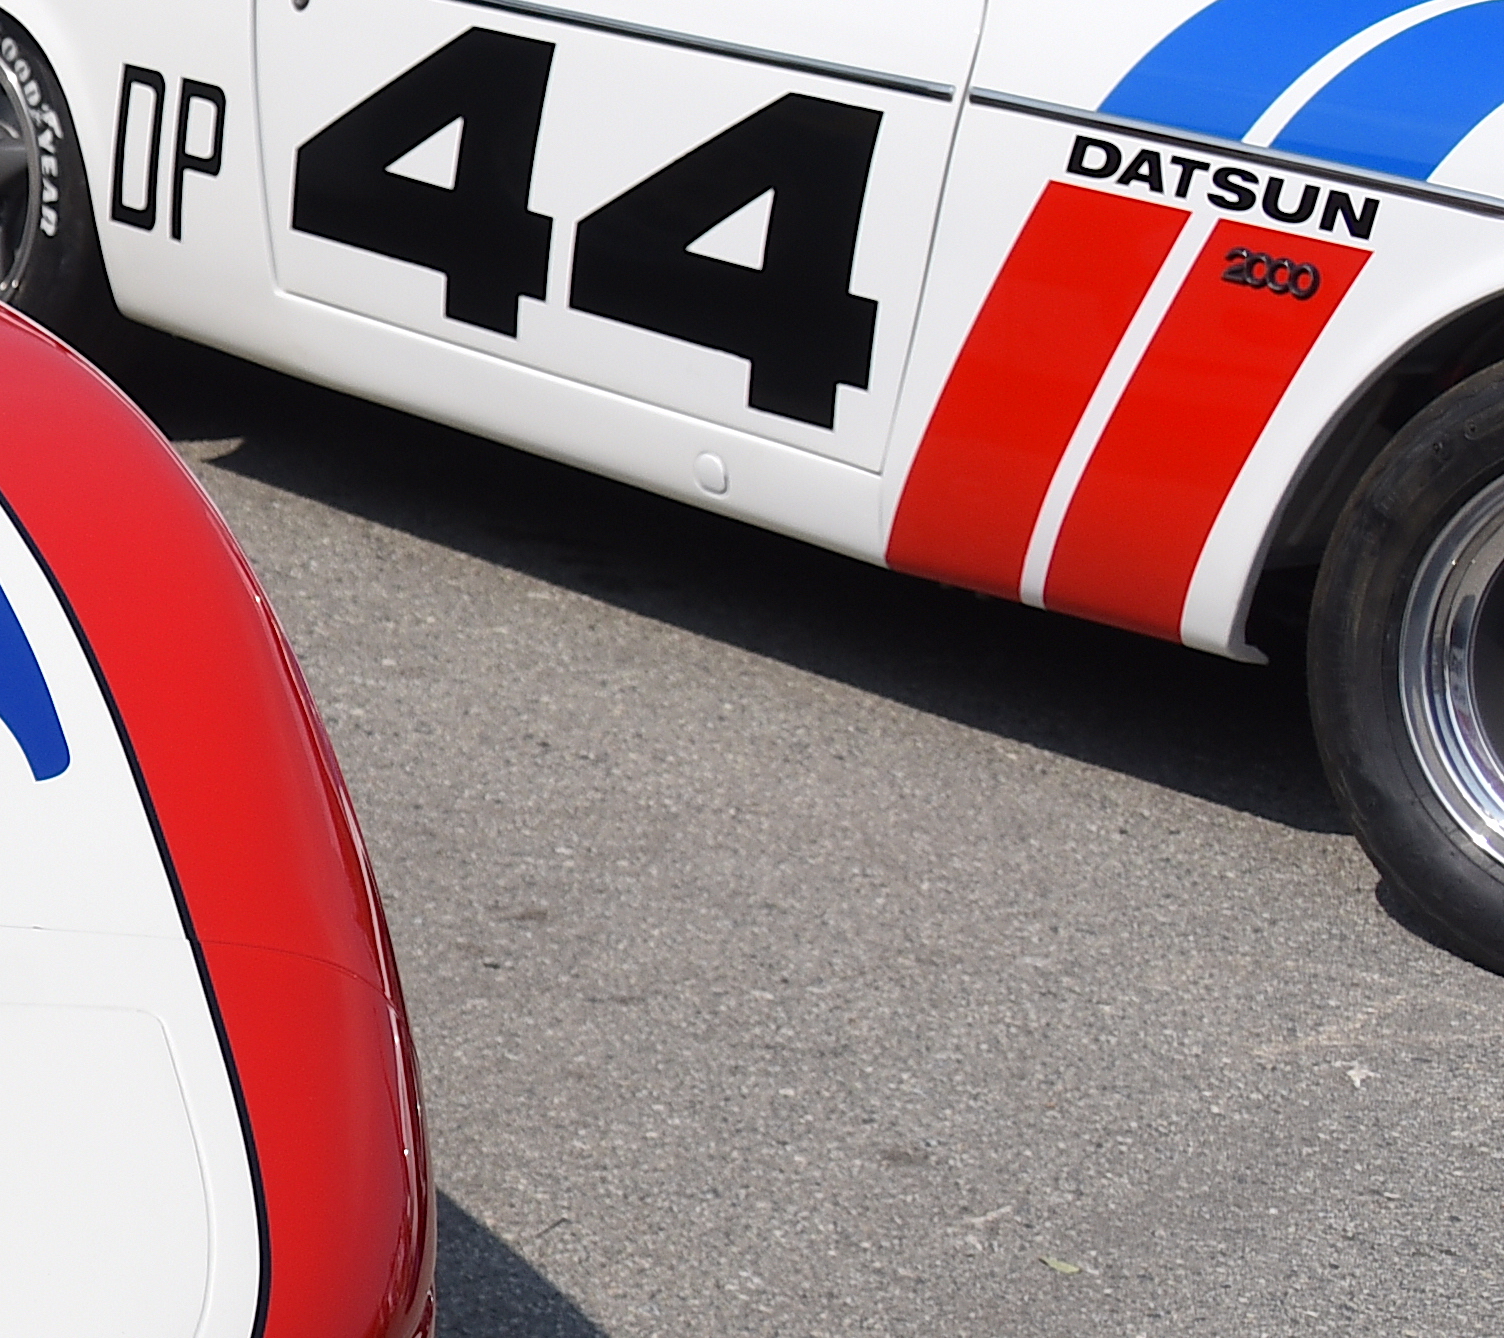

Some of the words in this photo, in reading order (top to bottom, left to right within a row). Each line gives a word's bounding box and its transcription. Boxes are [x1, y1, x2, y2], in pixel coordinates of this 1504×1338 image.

[110, 63, 228, 241] DP
[1065, 134, 1381, 241] DATSUN
[291, 26, 885, 431] 44
[1220, 246, 1322, 301] 2000
